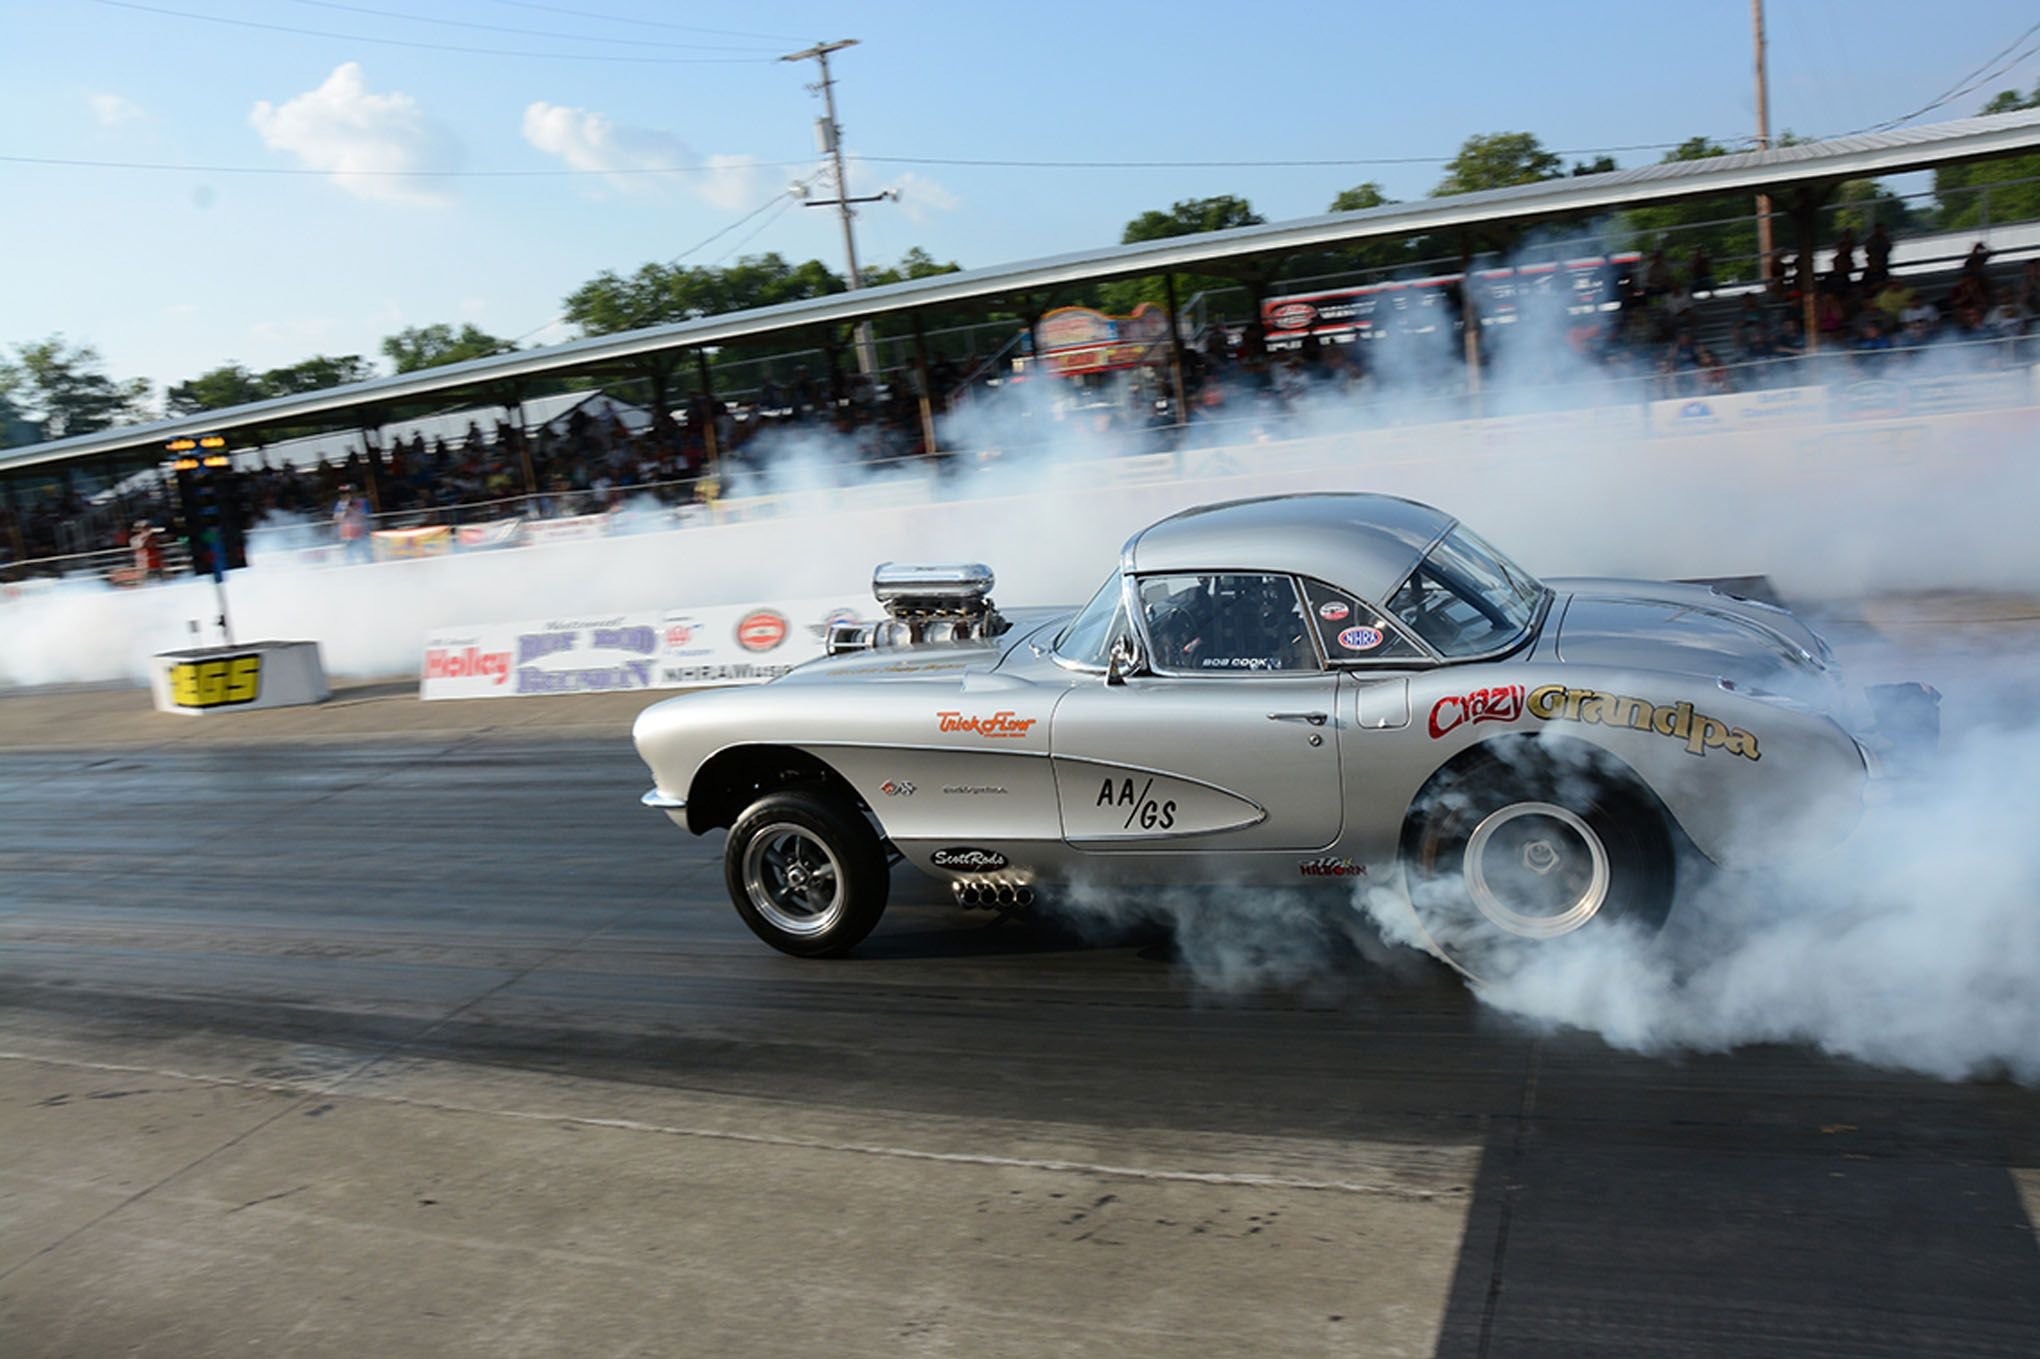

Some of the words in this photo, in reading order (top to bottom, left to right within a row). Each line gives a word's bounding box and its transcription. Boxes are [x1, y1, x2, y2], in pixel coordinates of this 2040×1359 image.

[1344, 630, 1378, 646] NHRA
[423, 646, 512, 685] Holley
[1203, 658, 1230, 667] BOB
[1231, 658, 1268, 668] COOK
[1428, 684, 1526, 740] Crazy
[1527, 685, 1761, 761] Grandpa
